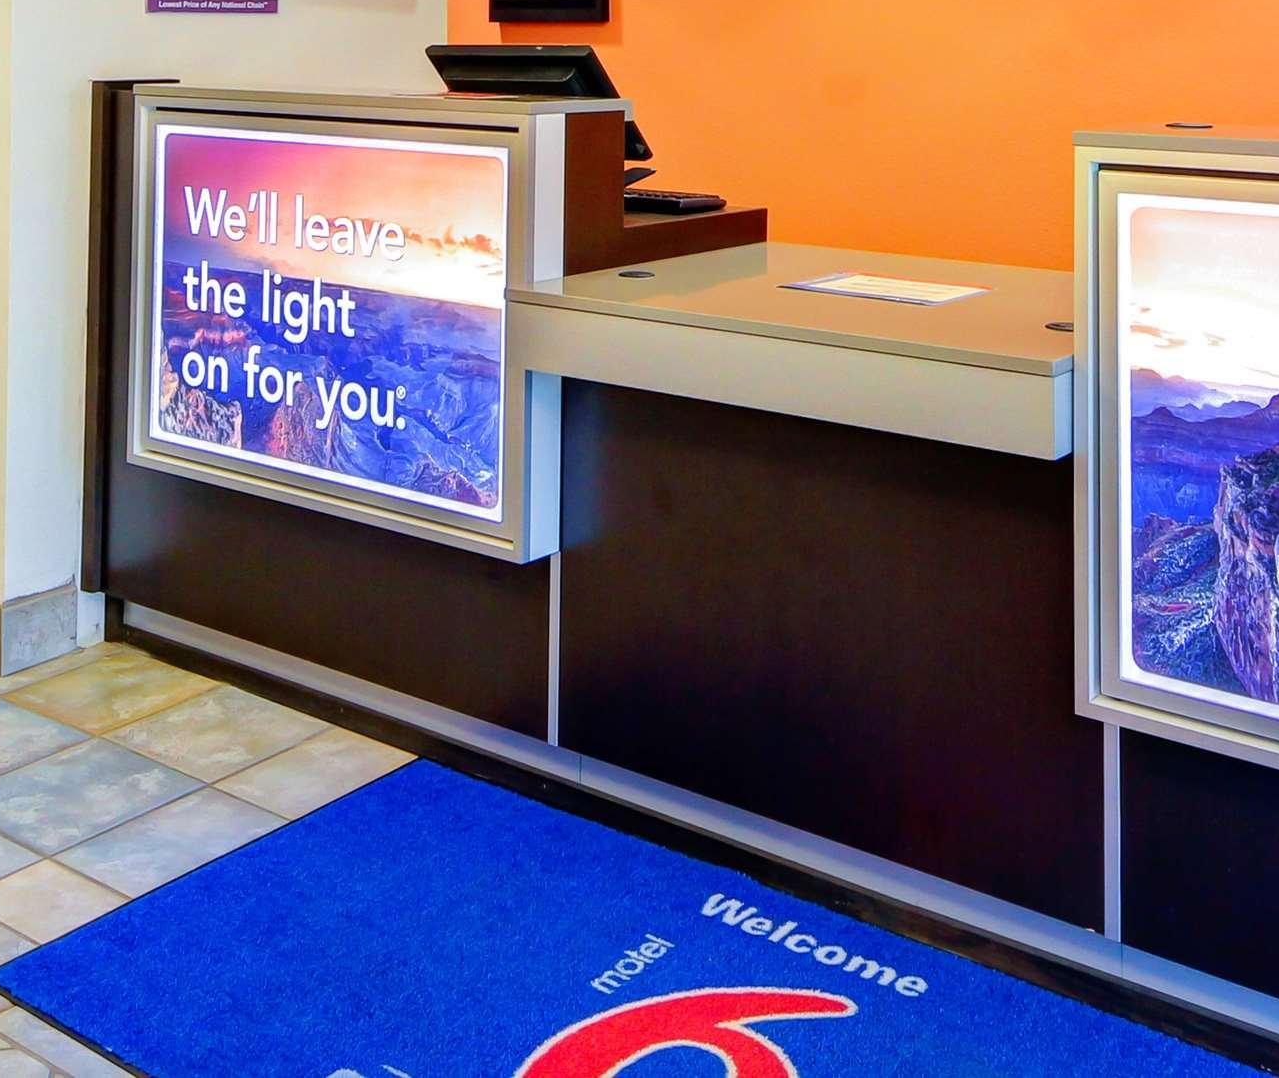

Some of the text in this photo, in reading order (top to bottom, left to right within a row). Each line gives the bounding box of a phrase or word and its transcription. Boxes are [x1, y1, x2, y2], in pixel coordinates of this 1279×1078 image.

[158, 0, 182, 9] Lowest
[183, 0, 199, 9] Price
[200, 1, 207, 9] of
[208, 1, 221, 10] Any
[222, 1, 246, 9] National
[184, 186, 406, 261] We'll leave
[182, 260, 357, 344] the light
[181, 352, 228, 393] on
[244, 345, 303, 406] for
[590, 933, 675, 995] motel
[700, 892, 929, 997] Welcome
